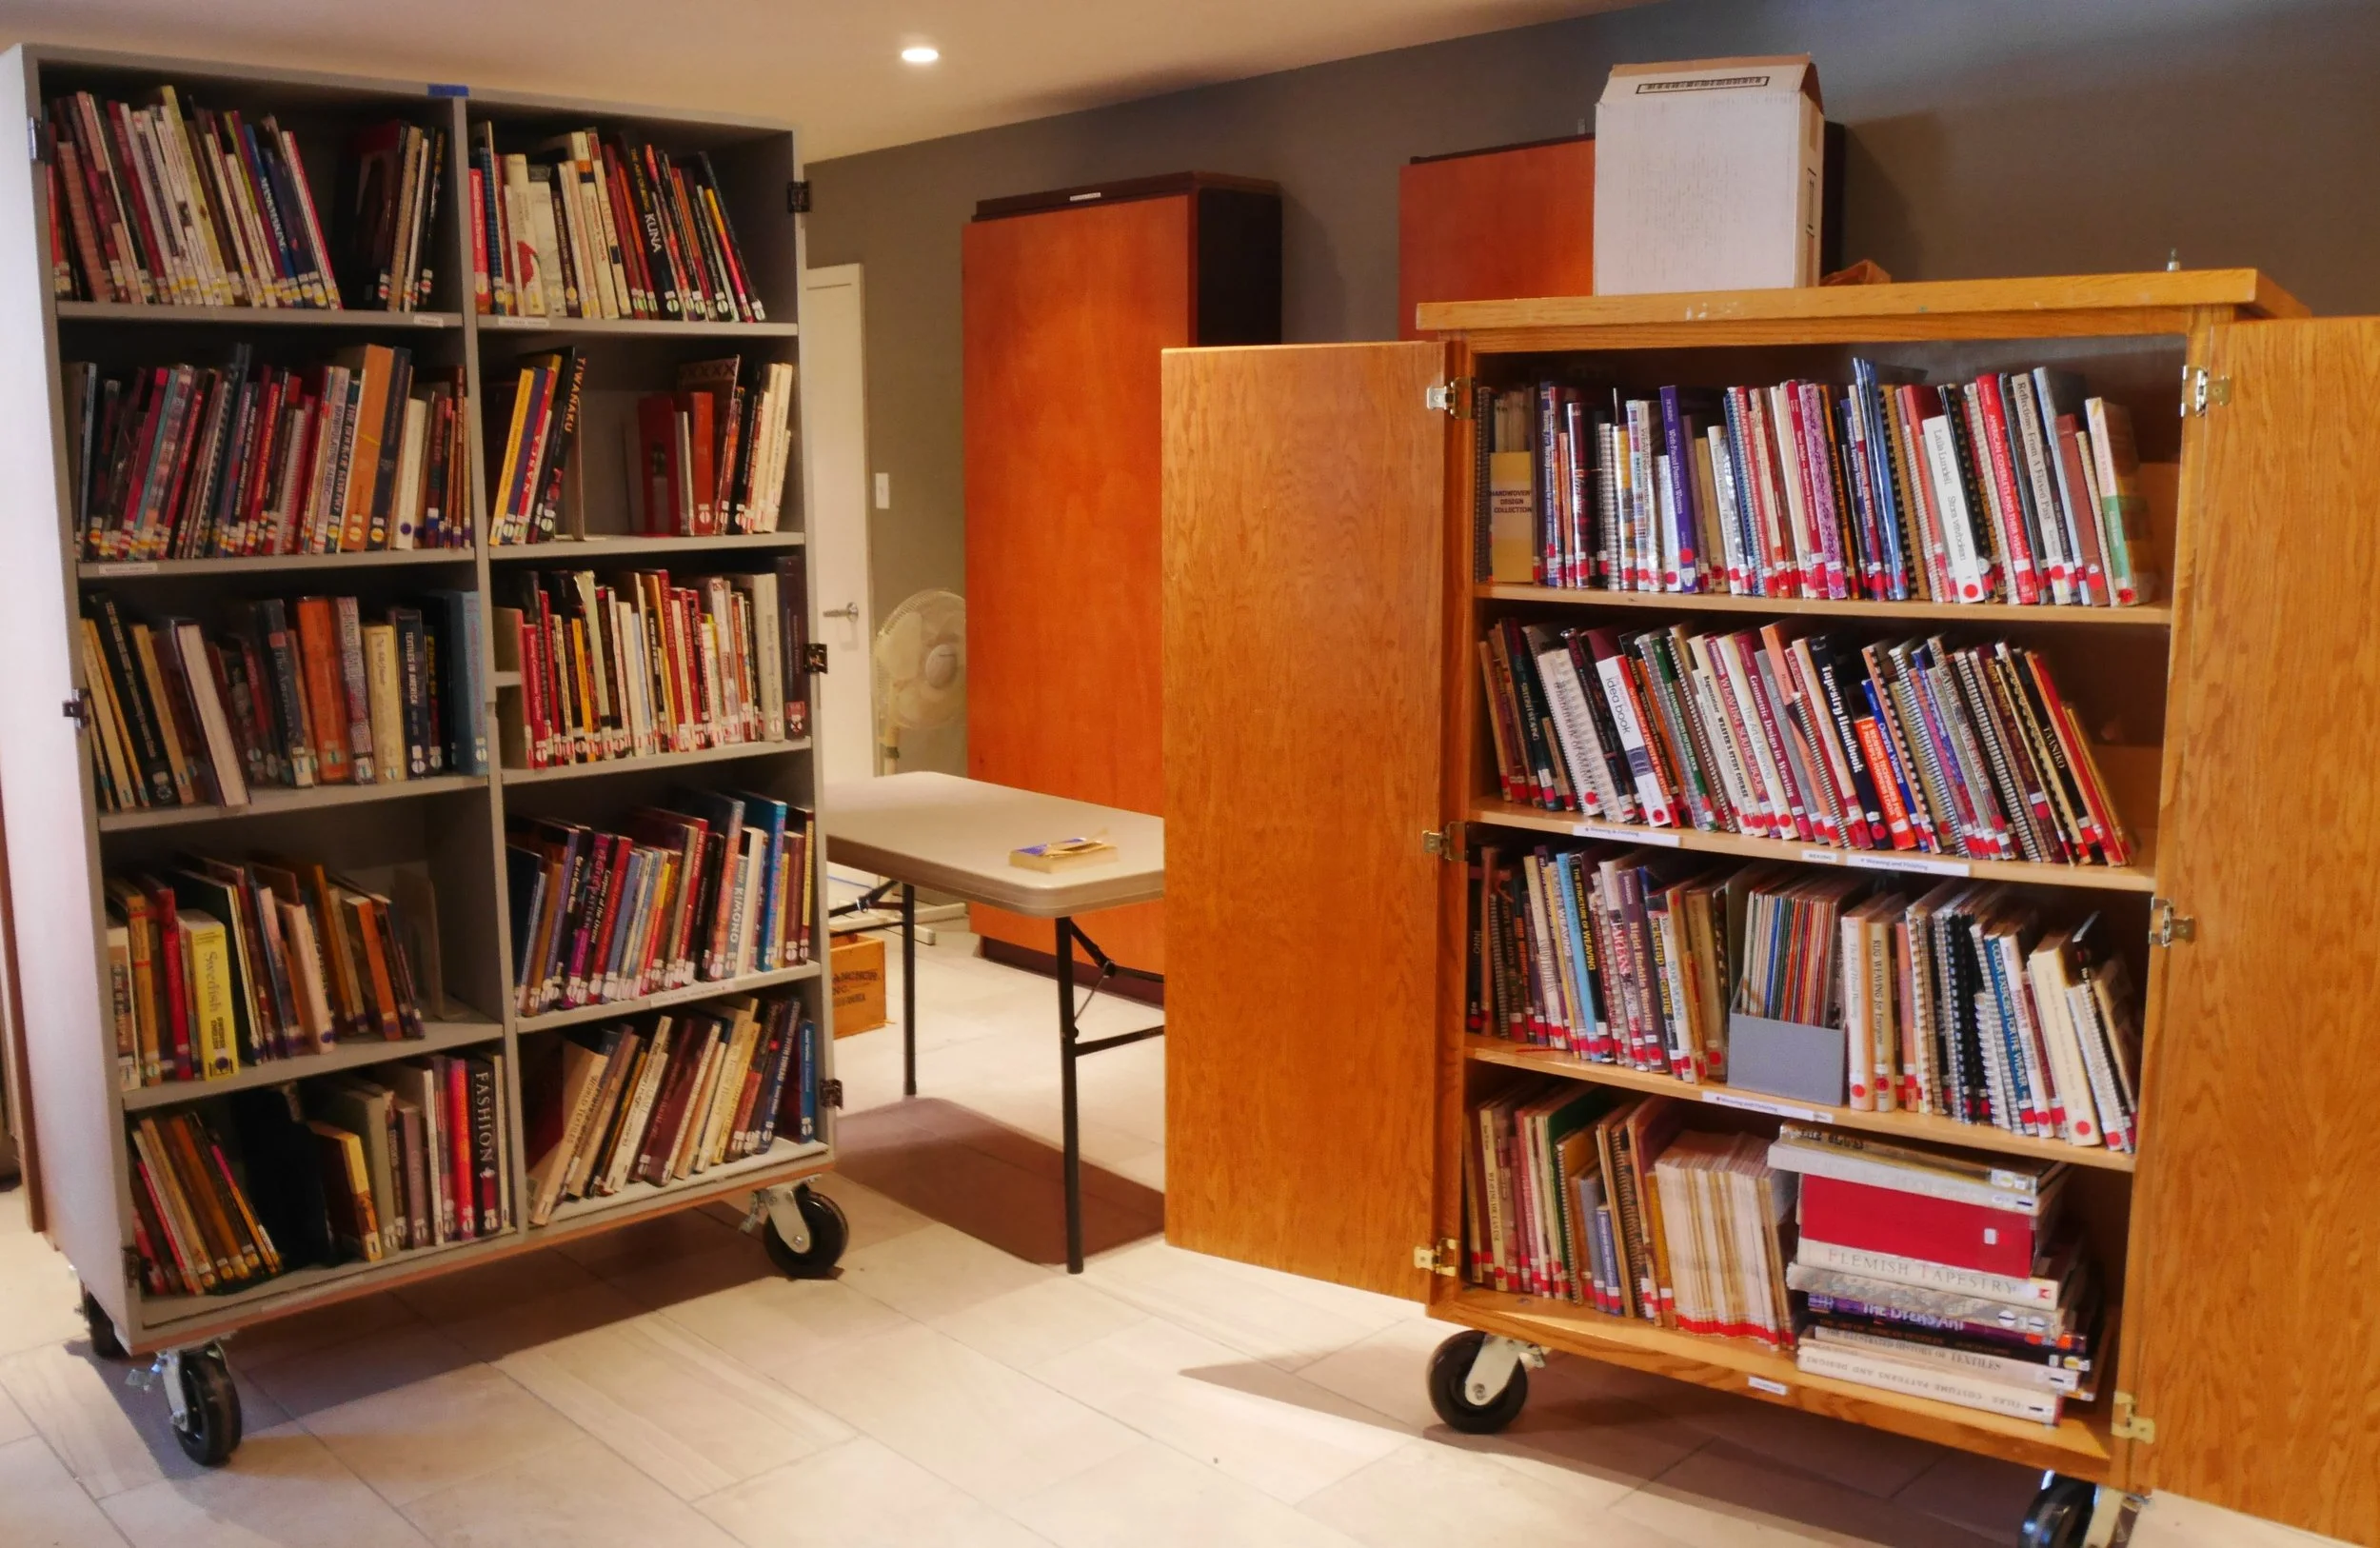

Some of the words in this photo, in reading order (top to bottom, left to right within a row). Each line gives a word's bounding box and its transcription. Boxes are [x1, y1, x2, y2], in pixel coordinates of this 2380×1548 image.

[644, 213, 663, 252] KUNA
[563, 357, 585, 432] TIWANAKU
[1668, 428, 1679, 465] Weft-Faced
[1934, 428, 1945, 451] Laila
[2017, 382, 2034, 430] Reflections
[2027, 431, 2039, 457] From
[2040, 501, 2052, 521] Past
[1672, 466, 1681, 488] Pattern
[1938, 451, 1953, 485] Lundell
[1988, 413, 2001, 453] AMERICAN
[1996, 454, 2010, 494] COVERLETS
[2008, 513, 2017, 532] THEIR
[1674, 488, 1684, 514] Weaves
[1947, 495, 1958, 518] Stora
[405, 631, 414, 663] TEXTILES
[407, 674, 417, 705] AMERICA
[1605, 676, 1621, 703] idea
[1614, 704, 1632, 734] book
[1702, 675, 1720, 713] Regensteiner
[1750, 675, 1770, 718] Geometric
[1744, 706, 1755, 722] The
[1749, 722, 1759, 736] Art
[1819, 664, 1845, 716] Tapestry
[1836, 715, 1864, 773] Handbook
[1719, 676, 1742, 725] WEAVING
[1735, 725, 1764, 793] SOURCEBOOK
[1763, 719, 1779, 748] Design
[2042, 726, 2065, 769] TAANIKO
[1755, 744, 1774, 779] Weaving
[1773, 749, 1782, 760] in
[1876, 722, 1894, 753] Overshot
[1888, 754, 1904, 784] Weaving
[1728, 750, 1739, 771] STUDY
[1735, 771, 1749, 798] COURSE
[1776, 761, 1795, 798] Weaving
[600, 869, 611, 897] Carpets
[728, 886, 744, 943] KIMONO
[1557, 908, 1572, 956] WEAVING
[1575, 882, 1587, 920] STRUCTURE
[1582, 931, 1596, 971] WEAVING
[1628, 922, 1641, 950] Rigid
[1873, 940, 1881, 956] RUG
[1633, 951, 1647, 987] Heddle
[1992, 943, 2004, 974] COLOR
[207, 951, 221, 1012] Swedish
[1874, 961, 1882, 998] WEAVING
[1997, 975, 2013, 1017] EXERCISES
[1638, 987, 1654, 1031] Weaving
[1671, 985, 1682, 1021] WEAVING
[1874, 1012, 1884, 1045] Everyone
[2006, 1017, 2016, 1035] FOR
[2010, 1036, 2020, 1051] THE
[777, 1056, 789, 1082] THREAD
[2013, 1052, 2028, 1087] WEAVER
[580, 1074, 598, 1107] WORLD
[475, 1072, 493, 1161] FASHION
[566, 1106, 585, 1145] TEXTILES
[1827, 1248, 1911, 1275] FLEMISH
[1916, 1264, 2017, 1294] TAPESTRY
[1862, 1303, 1887, 1317] THE
[1937, 1317, 1966, 1330] ART
[1803, 1356, 1847, 1372] DESIGNS
[1850, 1365, 1873, 1377] AND
[1876, 1371, 1928, 1389] PATTERNS
[1952, 1354, 2000, 1371] TEXTILES
[1932, 1382, 1981, 1399] COSTUME
